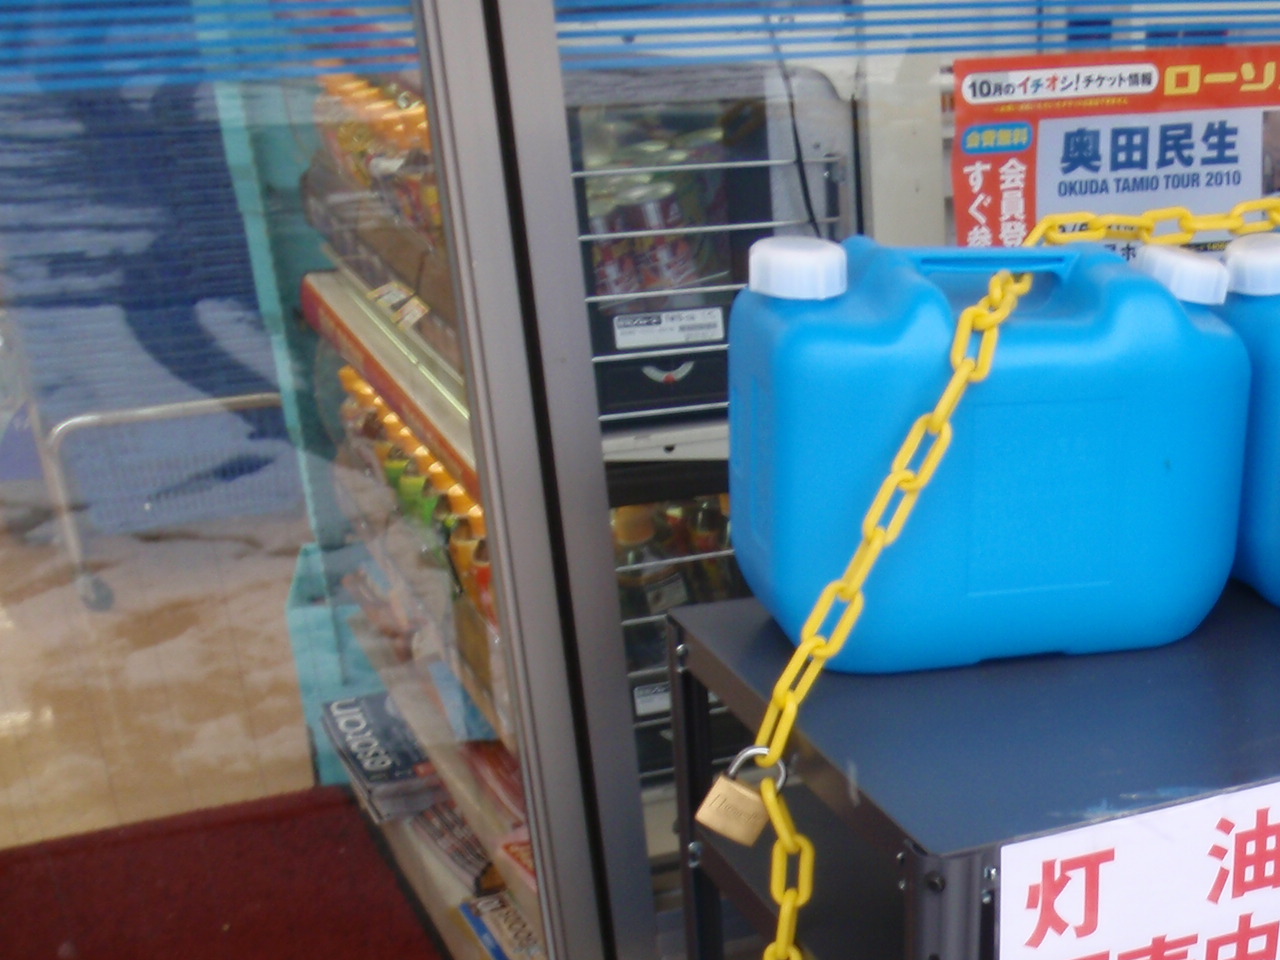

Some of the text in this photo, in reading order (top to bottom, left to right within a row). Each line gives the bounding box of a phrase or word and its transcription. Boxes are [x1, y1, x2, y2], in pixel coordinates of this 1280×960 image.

[1060, 119, 1240, 174] 奥田民生
[1058, 170, 1241, 197] OKUDA TAMIO TOUR 2010
